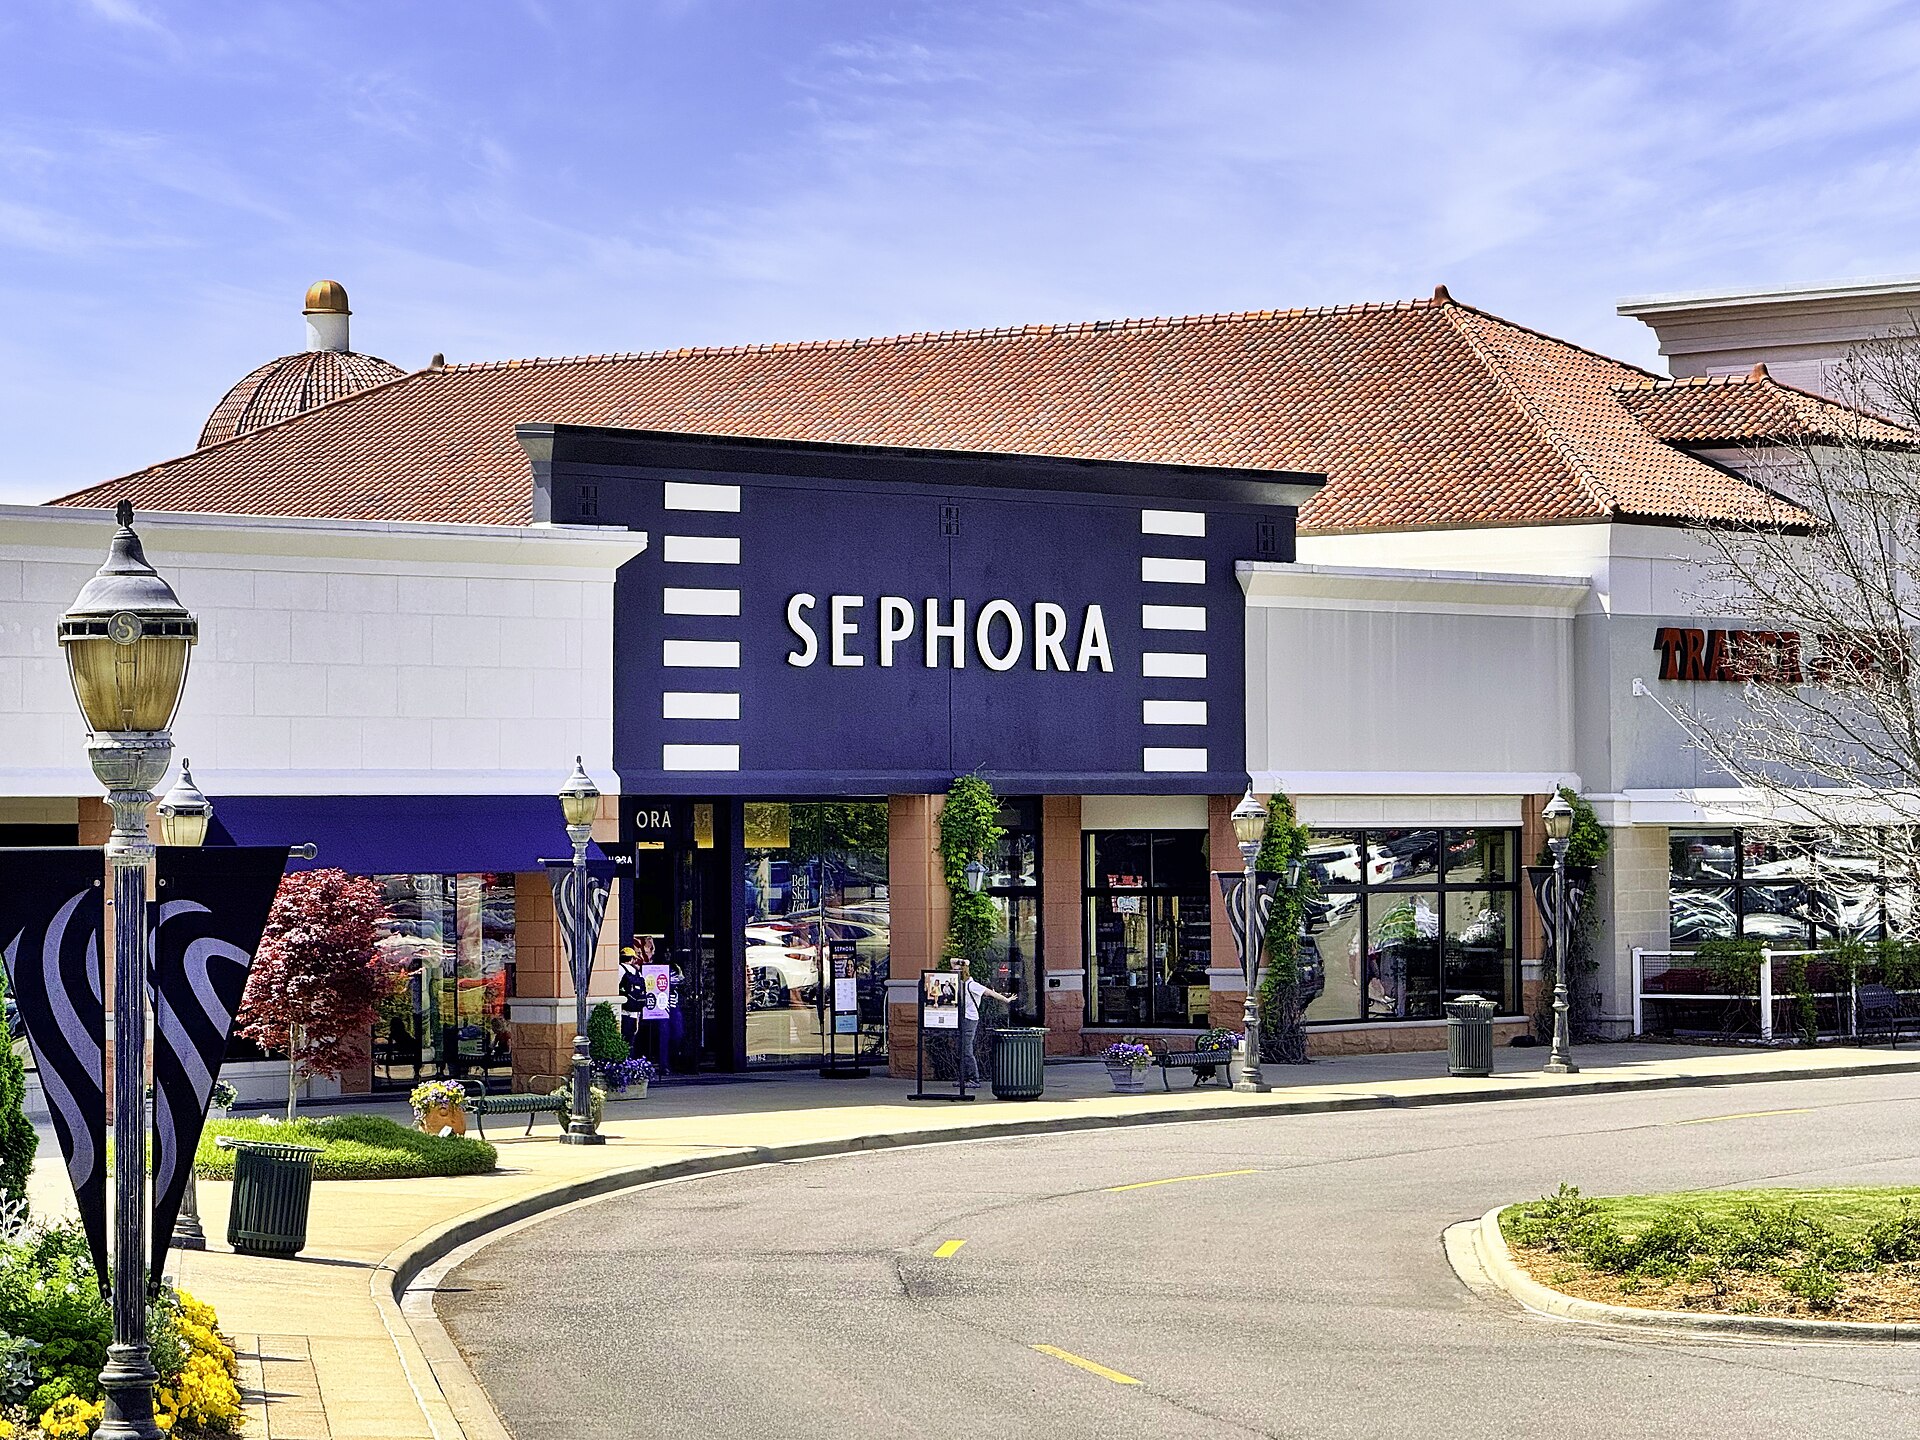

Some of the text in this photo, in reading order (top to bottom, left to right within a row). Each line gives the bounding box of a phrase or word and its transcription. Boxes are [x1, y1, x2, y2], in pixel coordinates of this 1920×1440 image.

[787, 592, 1115, 673] SEPHORA
[1653, 627, 1804, 683] TRAR
[636, 810, 672, 829] ORA
